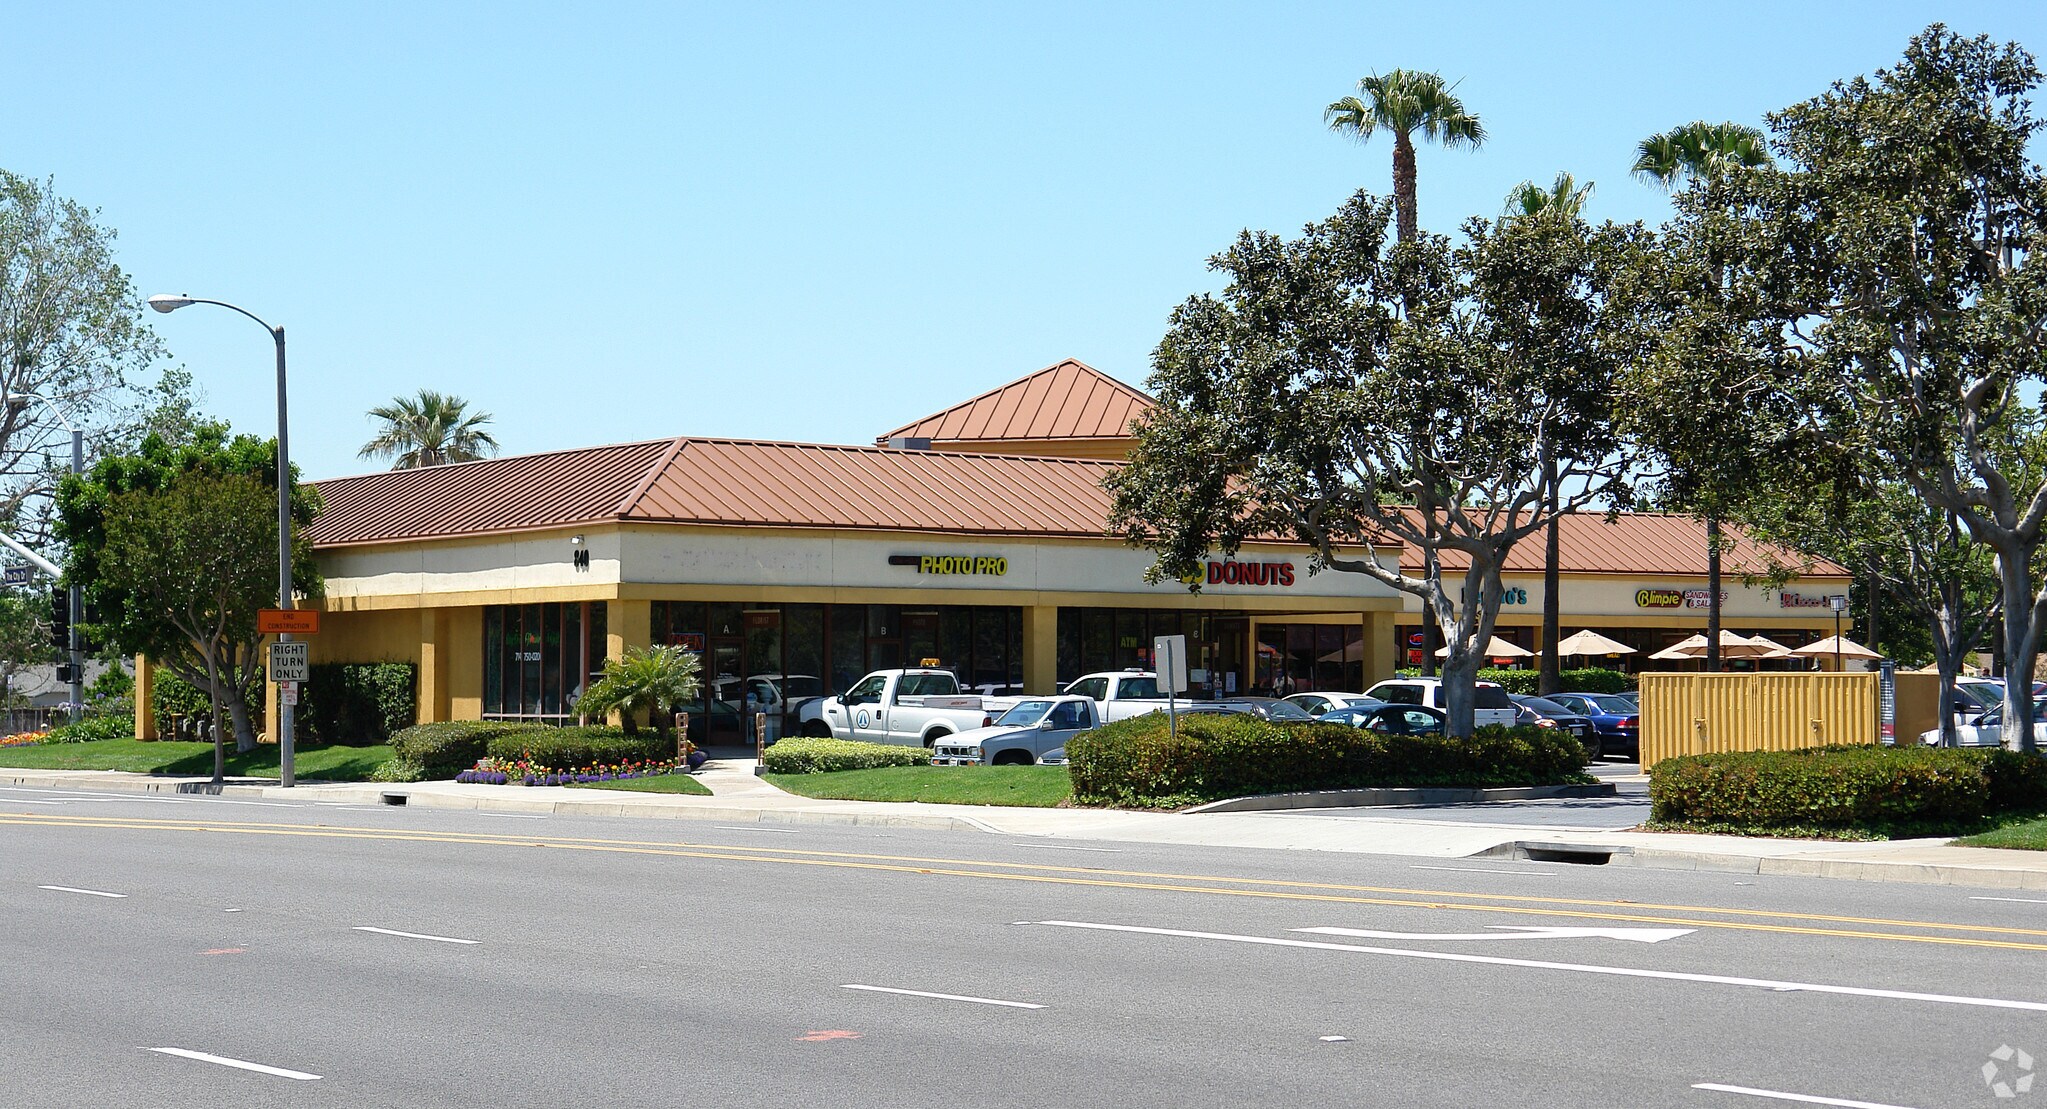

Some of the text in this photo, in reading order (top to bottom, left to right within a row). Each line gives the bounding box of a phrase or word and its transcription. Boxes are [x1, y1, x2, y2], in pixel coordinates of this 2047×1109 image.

[574, 550, 589, 567] 840
[919, 555, 972, 575] PHOTO
[974, 557, 1008, 576] PRO
[1208, 561, 1294, 586] DONUTS
[1637, 589, 1680, 608] Blimpie
[1685, 591, 1729, 600] SANDWES
[723, 624, 730, 634] A
[880, 626, 887, 636] B
[1120, 637, 1137, 648] ATM
[274, 645, 304, 655] RIGHT
[275, 657, 303, 667] TURN
[276, 669, 302, 679] ONLY
